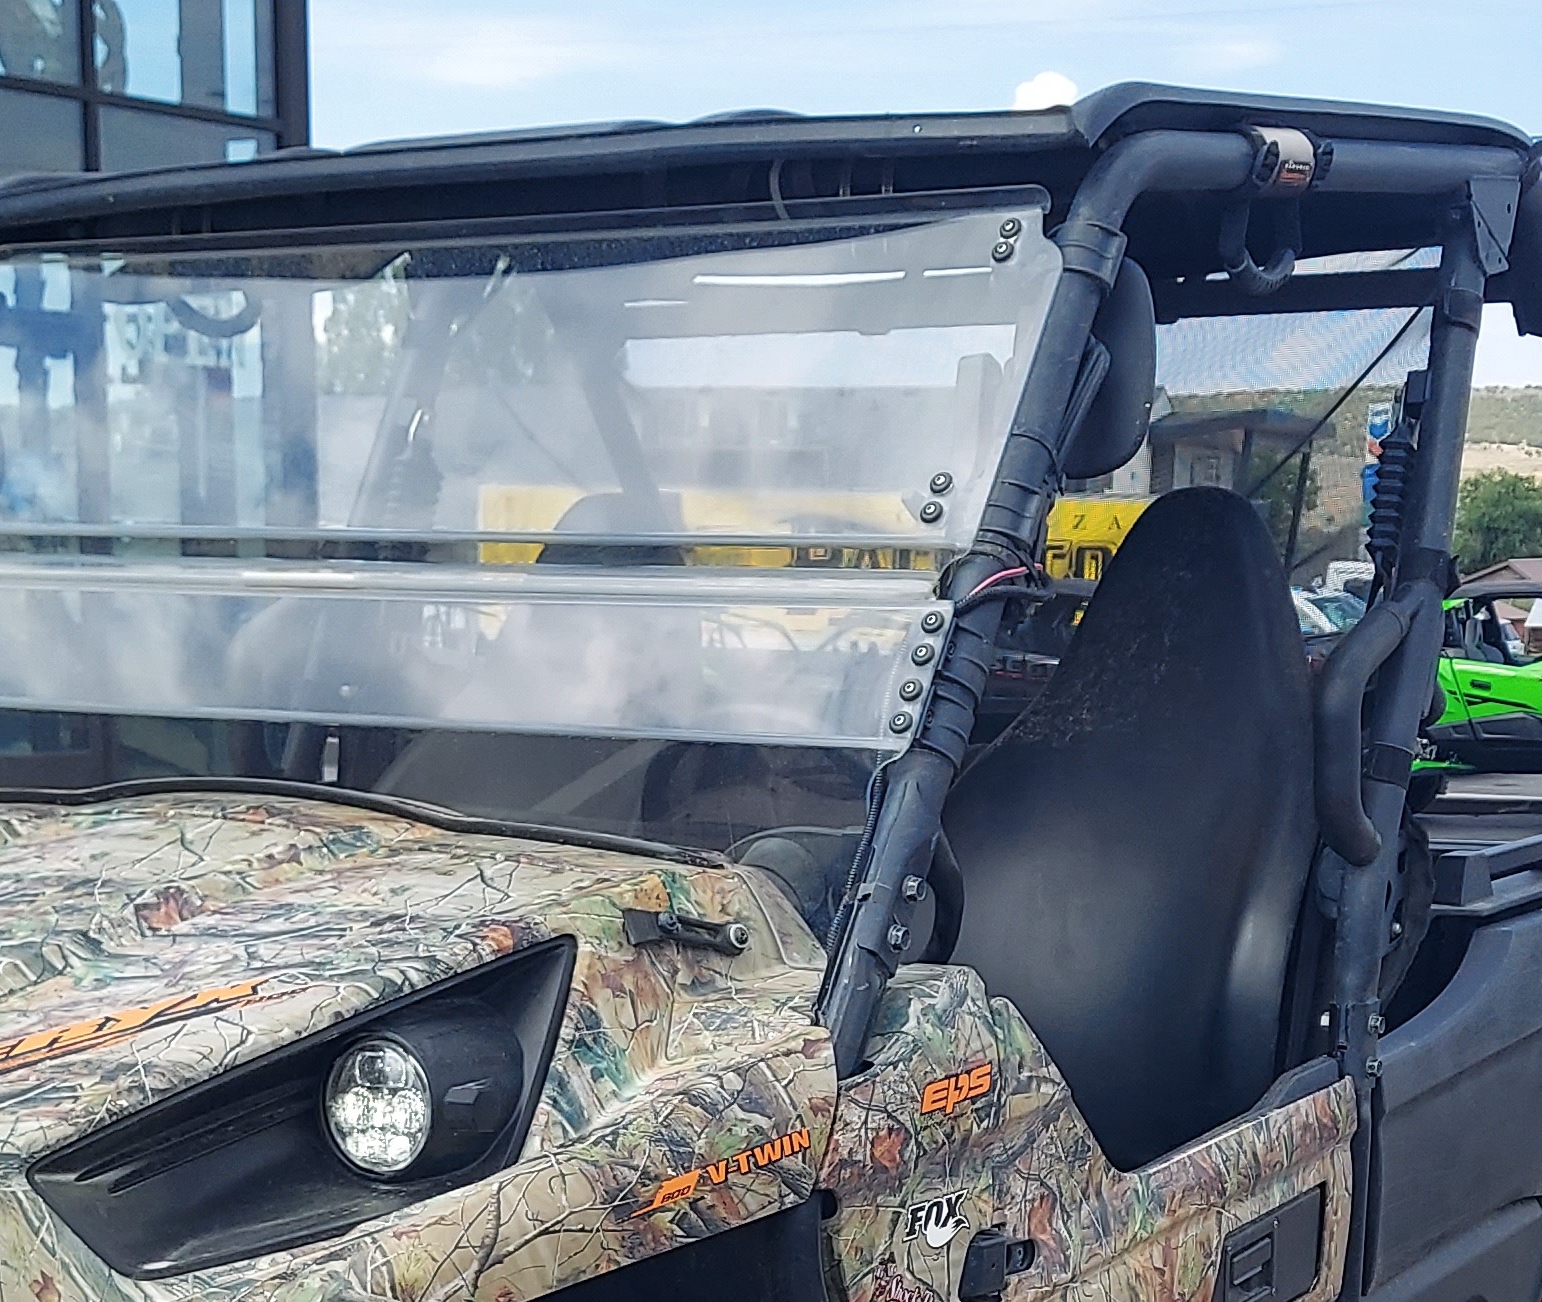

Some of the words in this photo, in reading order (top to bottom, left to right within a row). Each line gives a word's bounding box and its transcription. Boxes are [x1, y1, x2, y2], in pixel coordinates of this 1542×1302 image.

[920, 1062, 992, 1116] EPS
[705, 1127, 811, 1185] V-TWIN
[902, 1189, 968, 1241] FOX
